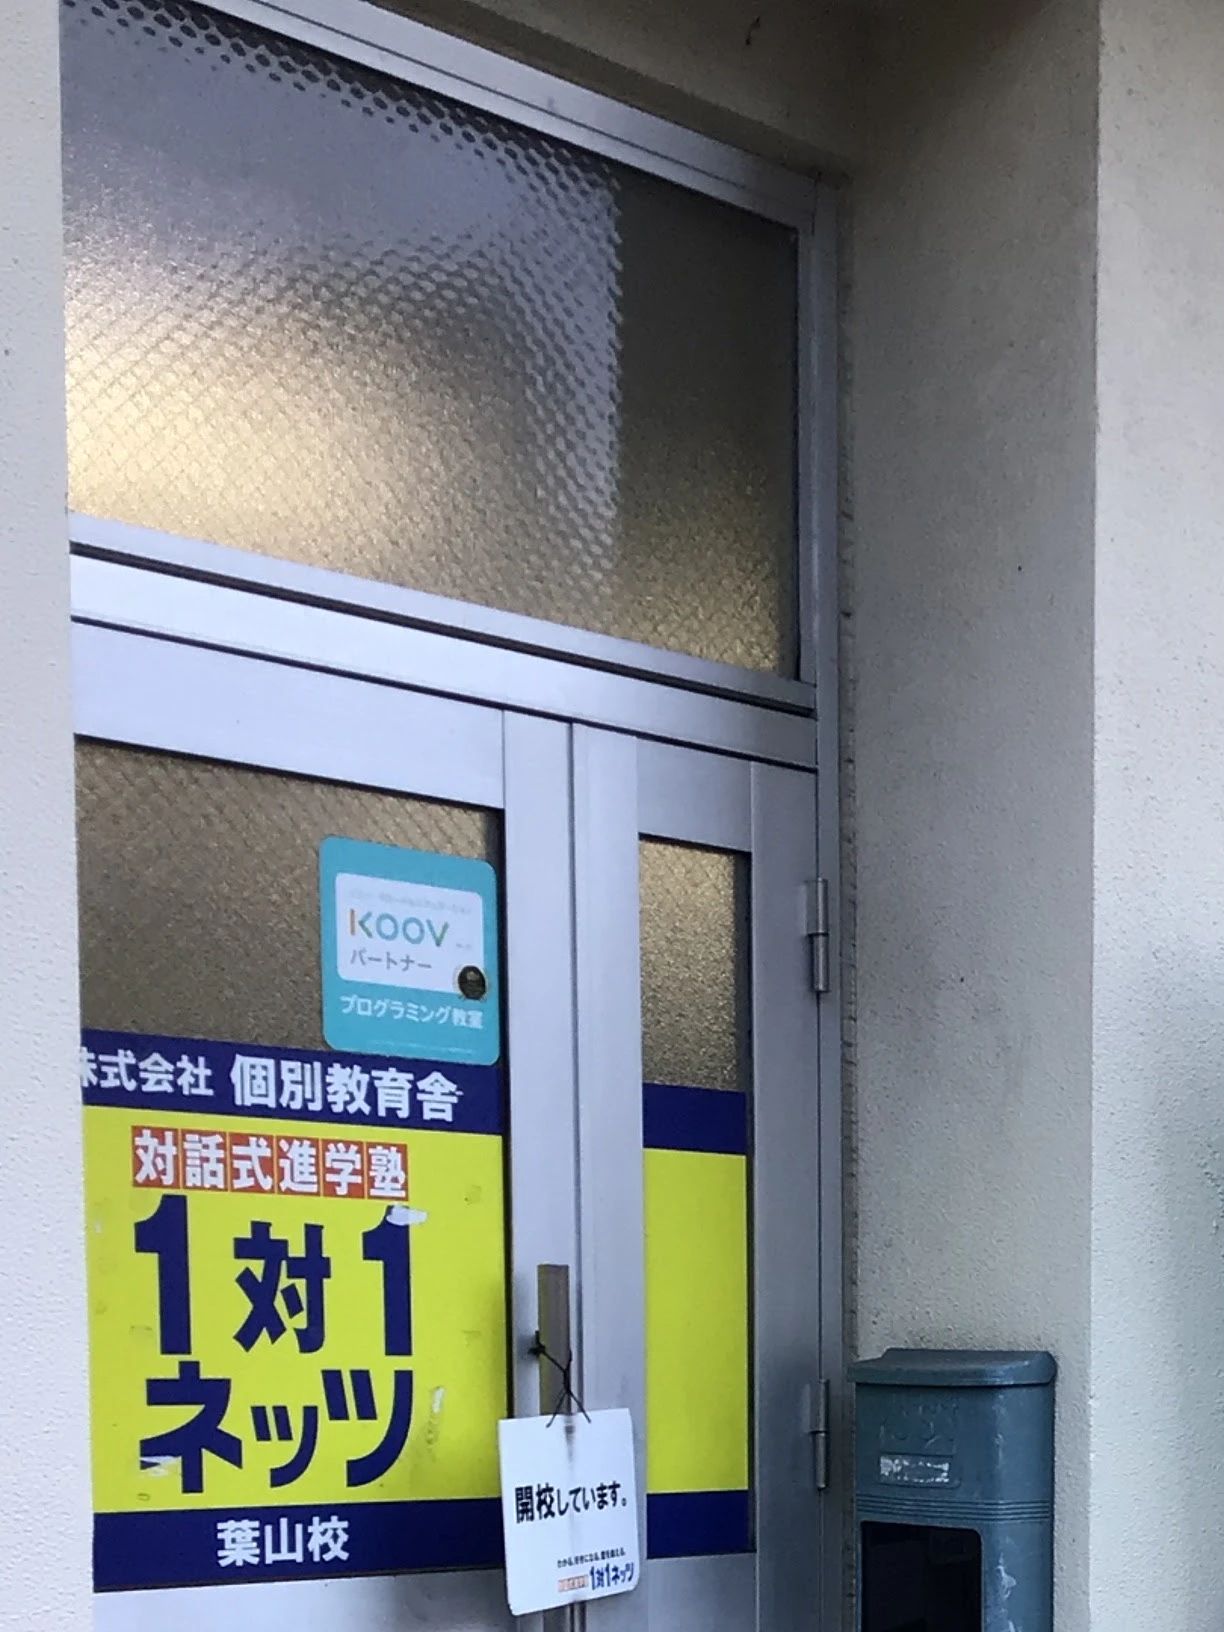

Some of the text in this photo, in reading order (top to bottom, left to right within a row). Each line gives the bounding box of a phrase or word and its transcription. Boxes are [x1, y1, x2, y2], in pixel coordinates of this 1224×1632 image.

[350, 908, 450, 947] KOOV
[229, 1053, 460, 1123] 個別教育舎
[133, 1129, 408, 1199] 対話式進学塾
[133, 1193, 414, 1357] 1対1
[139, 1360, 414, 1494] ネッツ
[514, 1480, 628, 1524] 開校しています。
[216, 1517, 351, 1568] 葉山校
